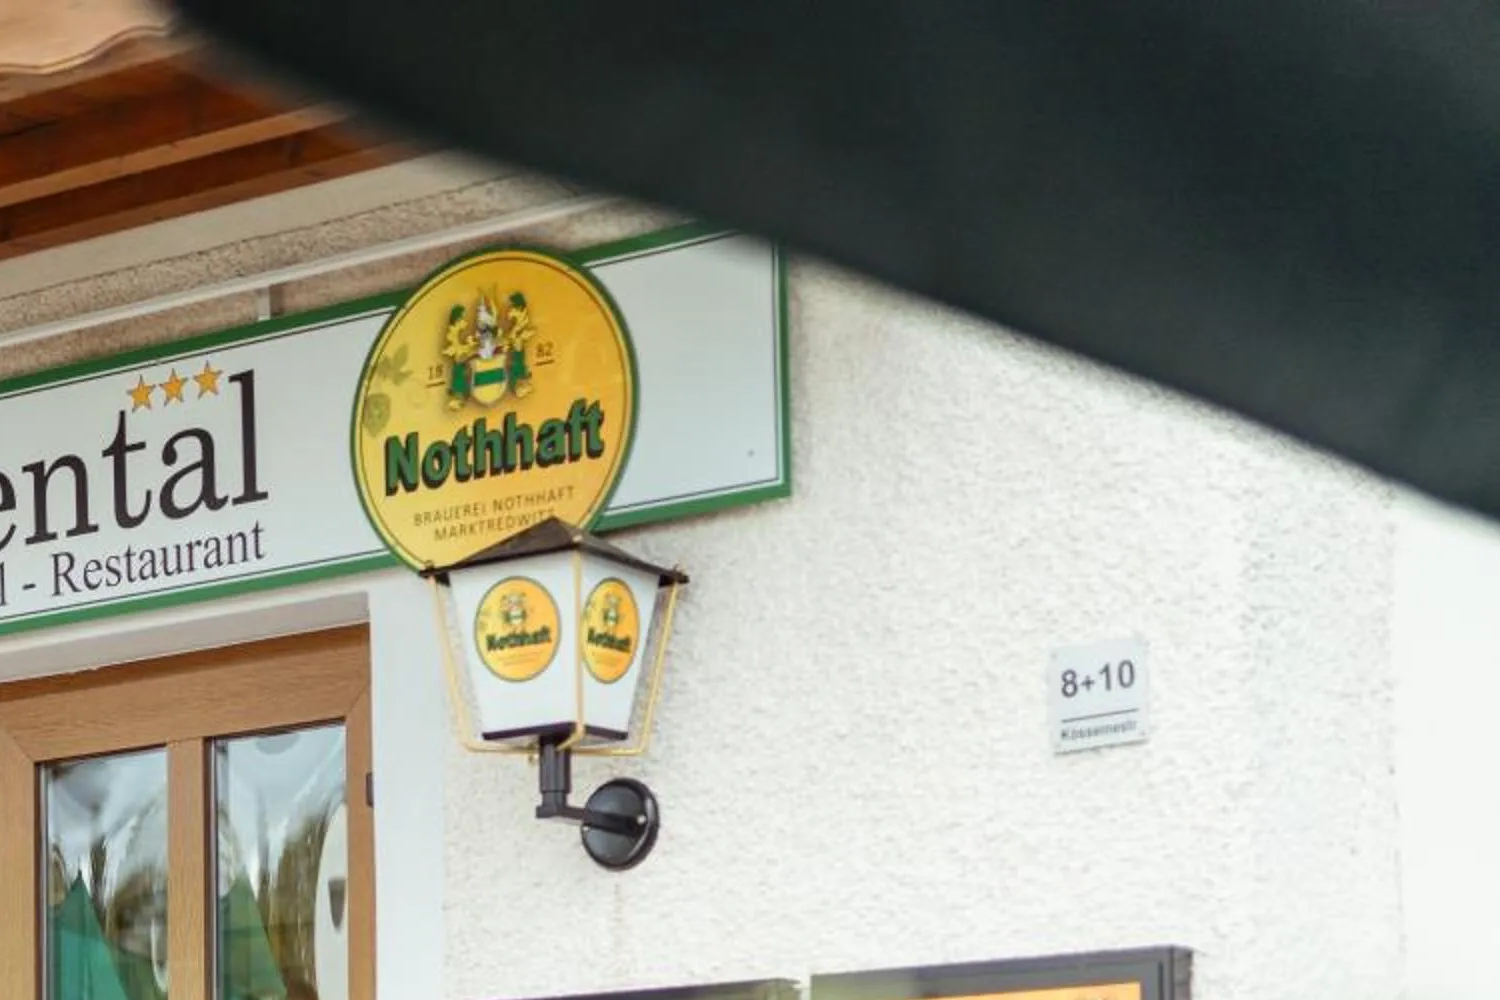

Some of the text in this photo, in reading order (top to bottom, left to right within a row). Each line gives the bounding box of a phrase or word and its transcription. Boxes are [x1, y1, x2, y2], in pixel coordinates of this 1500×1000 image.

[385, 397, 605, 496] Nothhaft
[414, 485, 576, 527] BRAUEREI NOTHHAFT
[51, 519, 266, 597] Restaurant
[1061, 659, 1135, 698] 8+10
